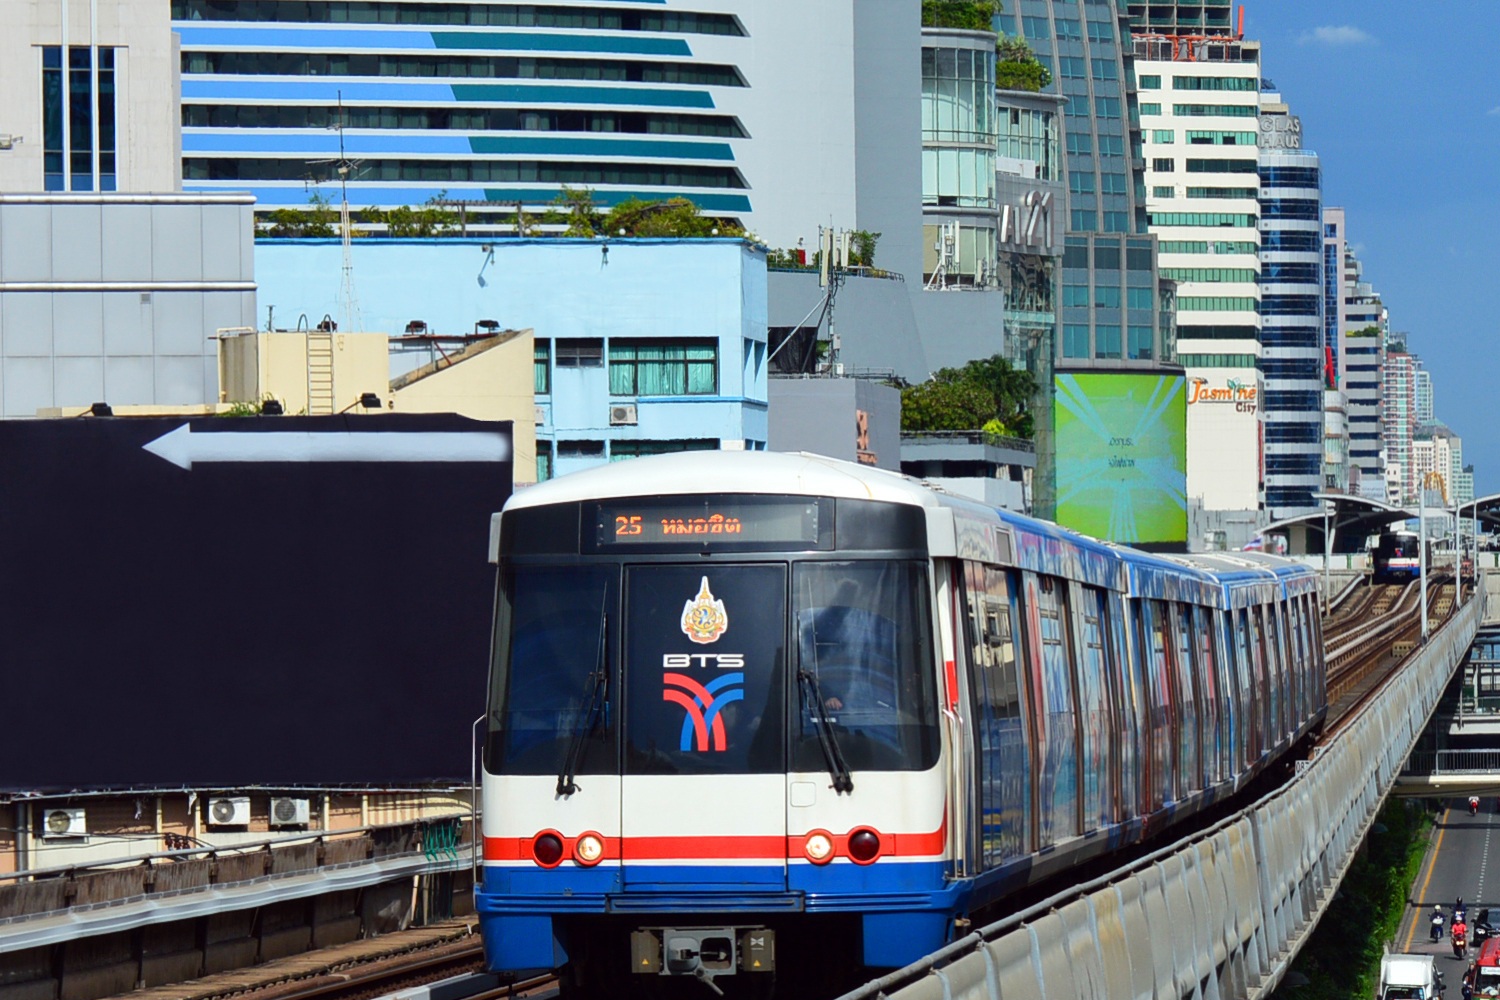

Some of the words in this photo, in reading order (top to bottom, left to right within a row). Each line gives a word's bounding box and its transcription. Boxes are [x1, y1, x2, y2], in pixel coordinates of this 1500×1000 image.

[1260, 117, 1300, 132] GLAS
[1259, 133, 1299, 149] HAUS
[1025, 190, 1054, 249] 21
[1187, 377, 1257, 405] Jasmine
[1236, 402, 1257, 415] City
[615, 515, 643, 535] 25
[661, 513, 741, 534] หมอชิต
[663, 653, 745, 668] BTS
